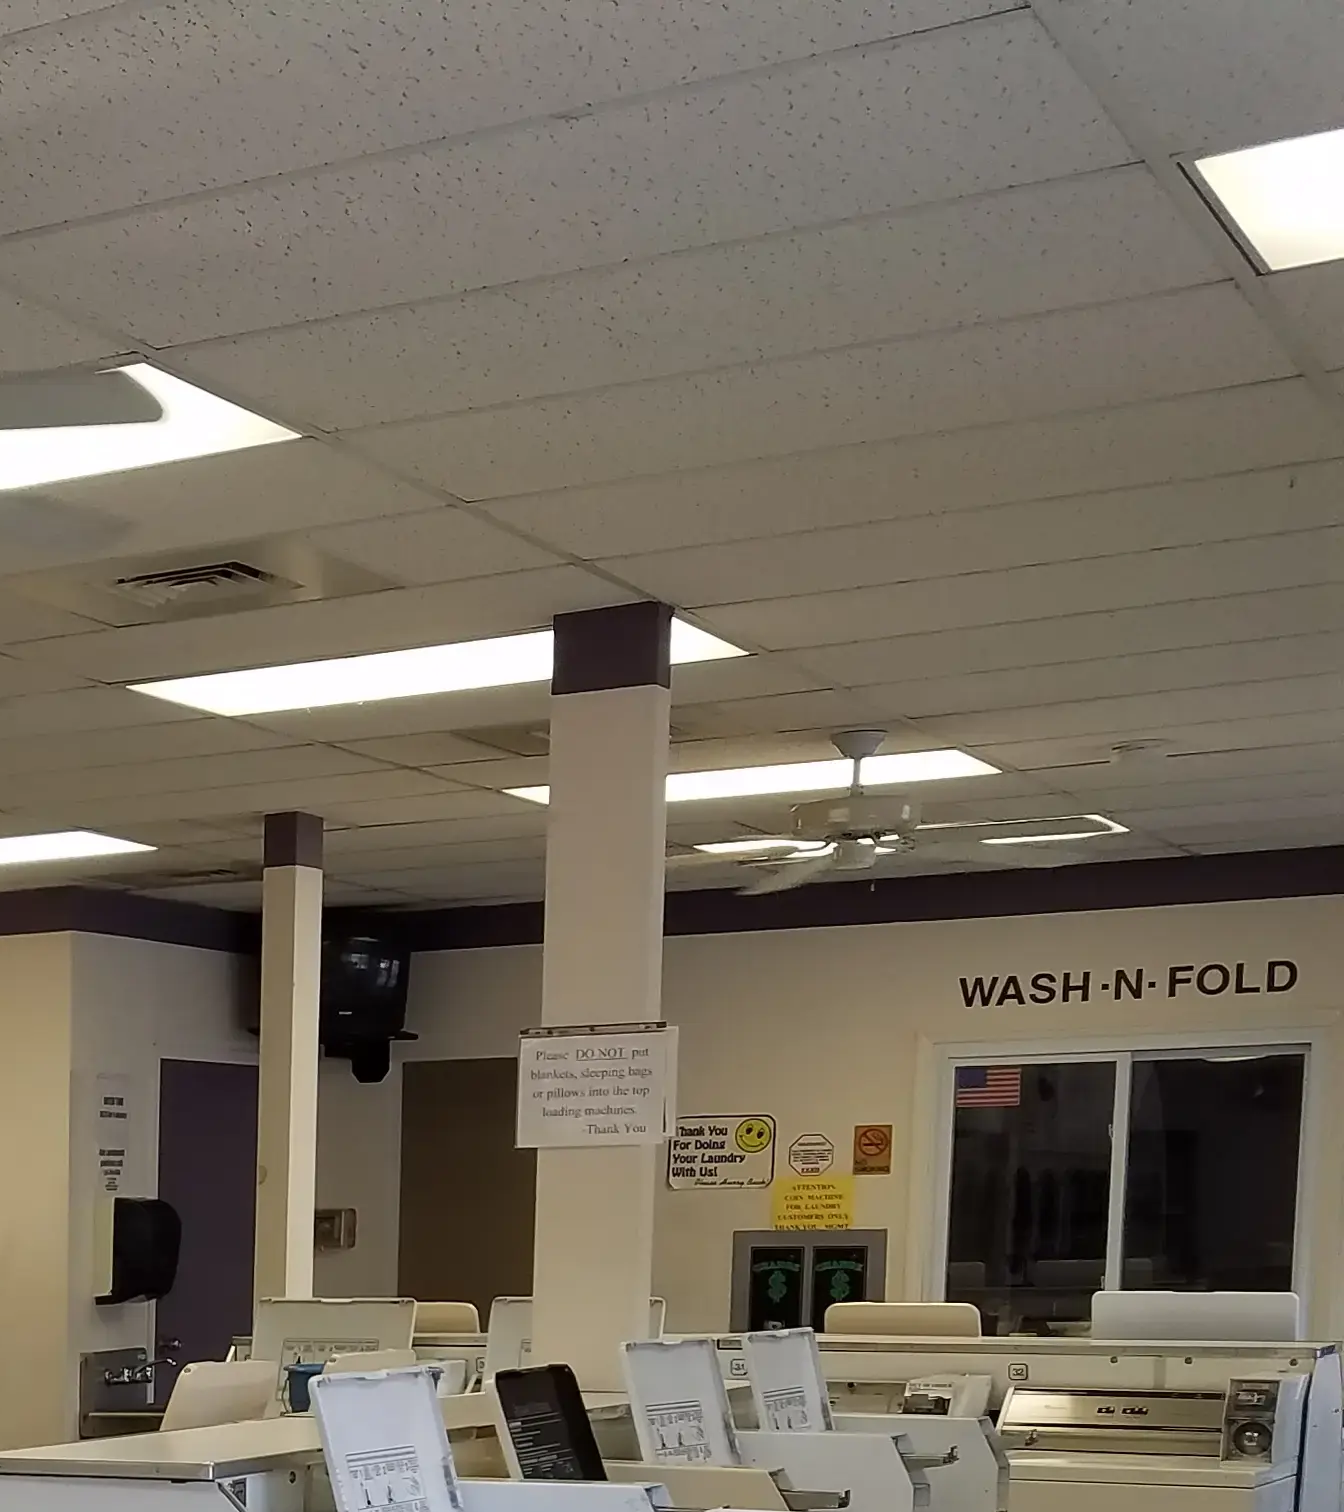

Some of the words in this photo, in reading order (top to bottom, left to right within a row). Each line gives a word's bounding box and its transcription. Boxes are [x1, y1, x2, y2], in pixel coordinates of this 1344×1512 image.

[536, 1051, 569, 1060] Please
[576, 1049, 594, 1059] DO
[598, 1048, 625, 1058] NOT
[632, 1049, 649, 1059] put
[629, 1067, 652, 1076] bags
[547, 1088, 584, 1100] pillows
[589, 1088, 609, 1097] into
[613, 1086, 629, 1096] the
[633, 1087, 649, 1097] top
[543, 1107, 581, 1118] loading
[625, 1124, 646, 1133] You
[708, 1126, 727, 1135] You
[673, 1141, 691, 1150] For
[695, 1140, 725, 1149] Doing
[673, 1154, 697, 1163] Your
[701, 1153, 745, 1163] Laundry
[672, 1167, 696, 1177] With
[700, 1167, 717, 1177] Us!
